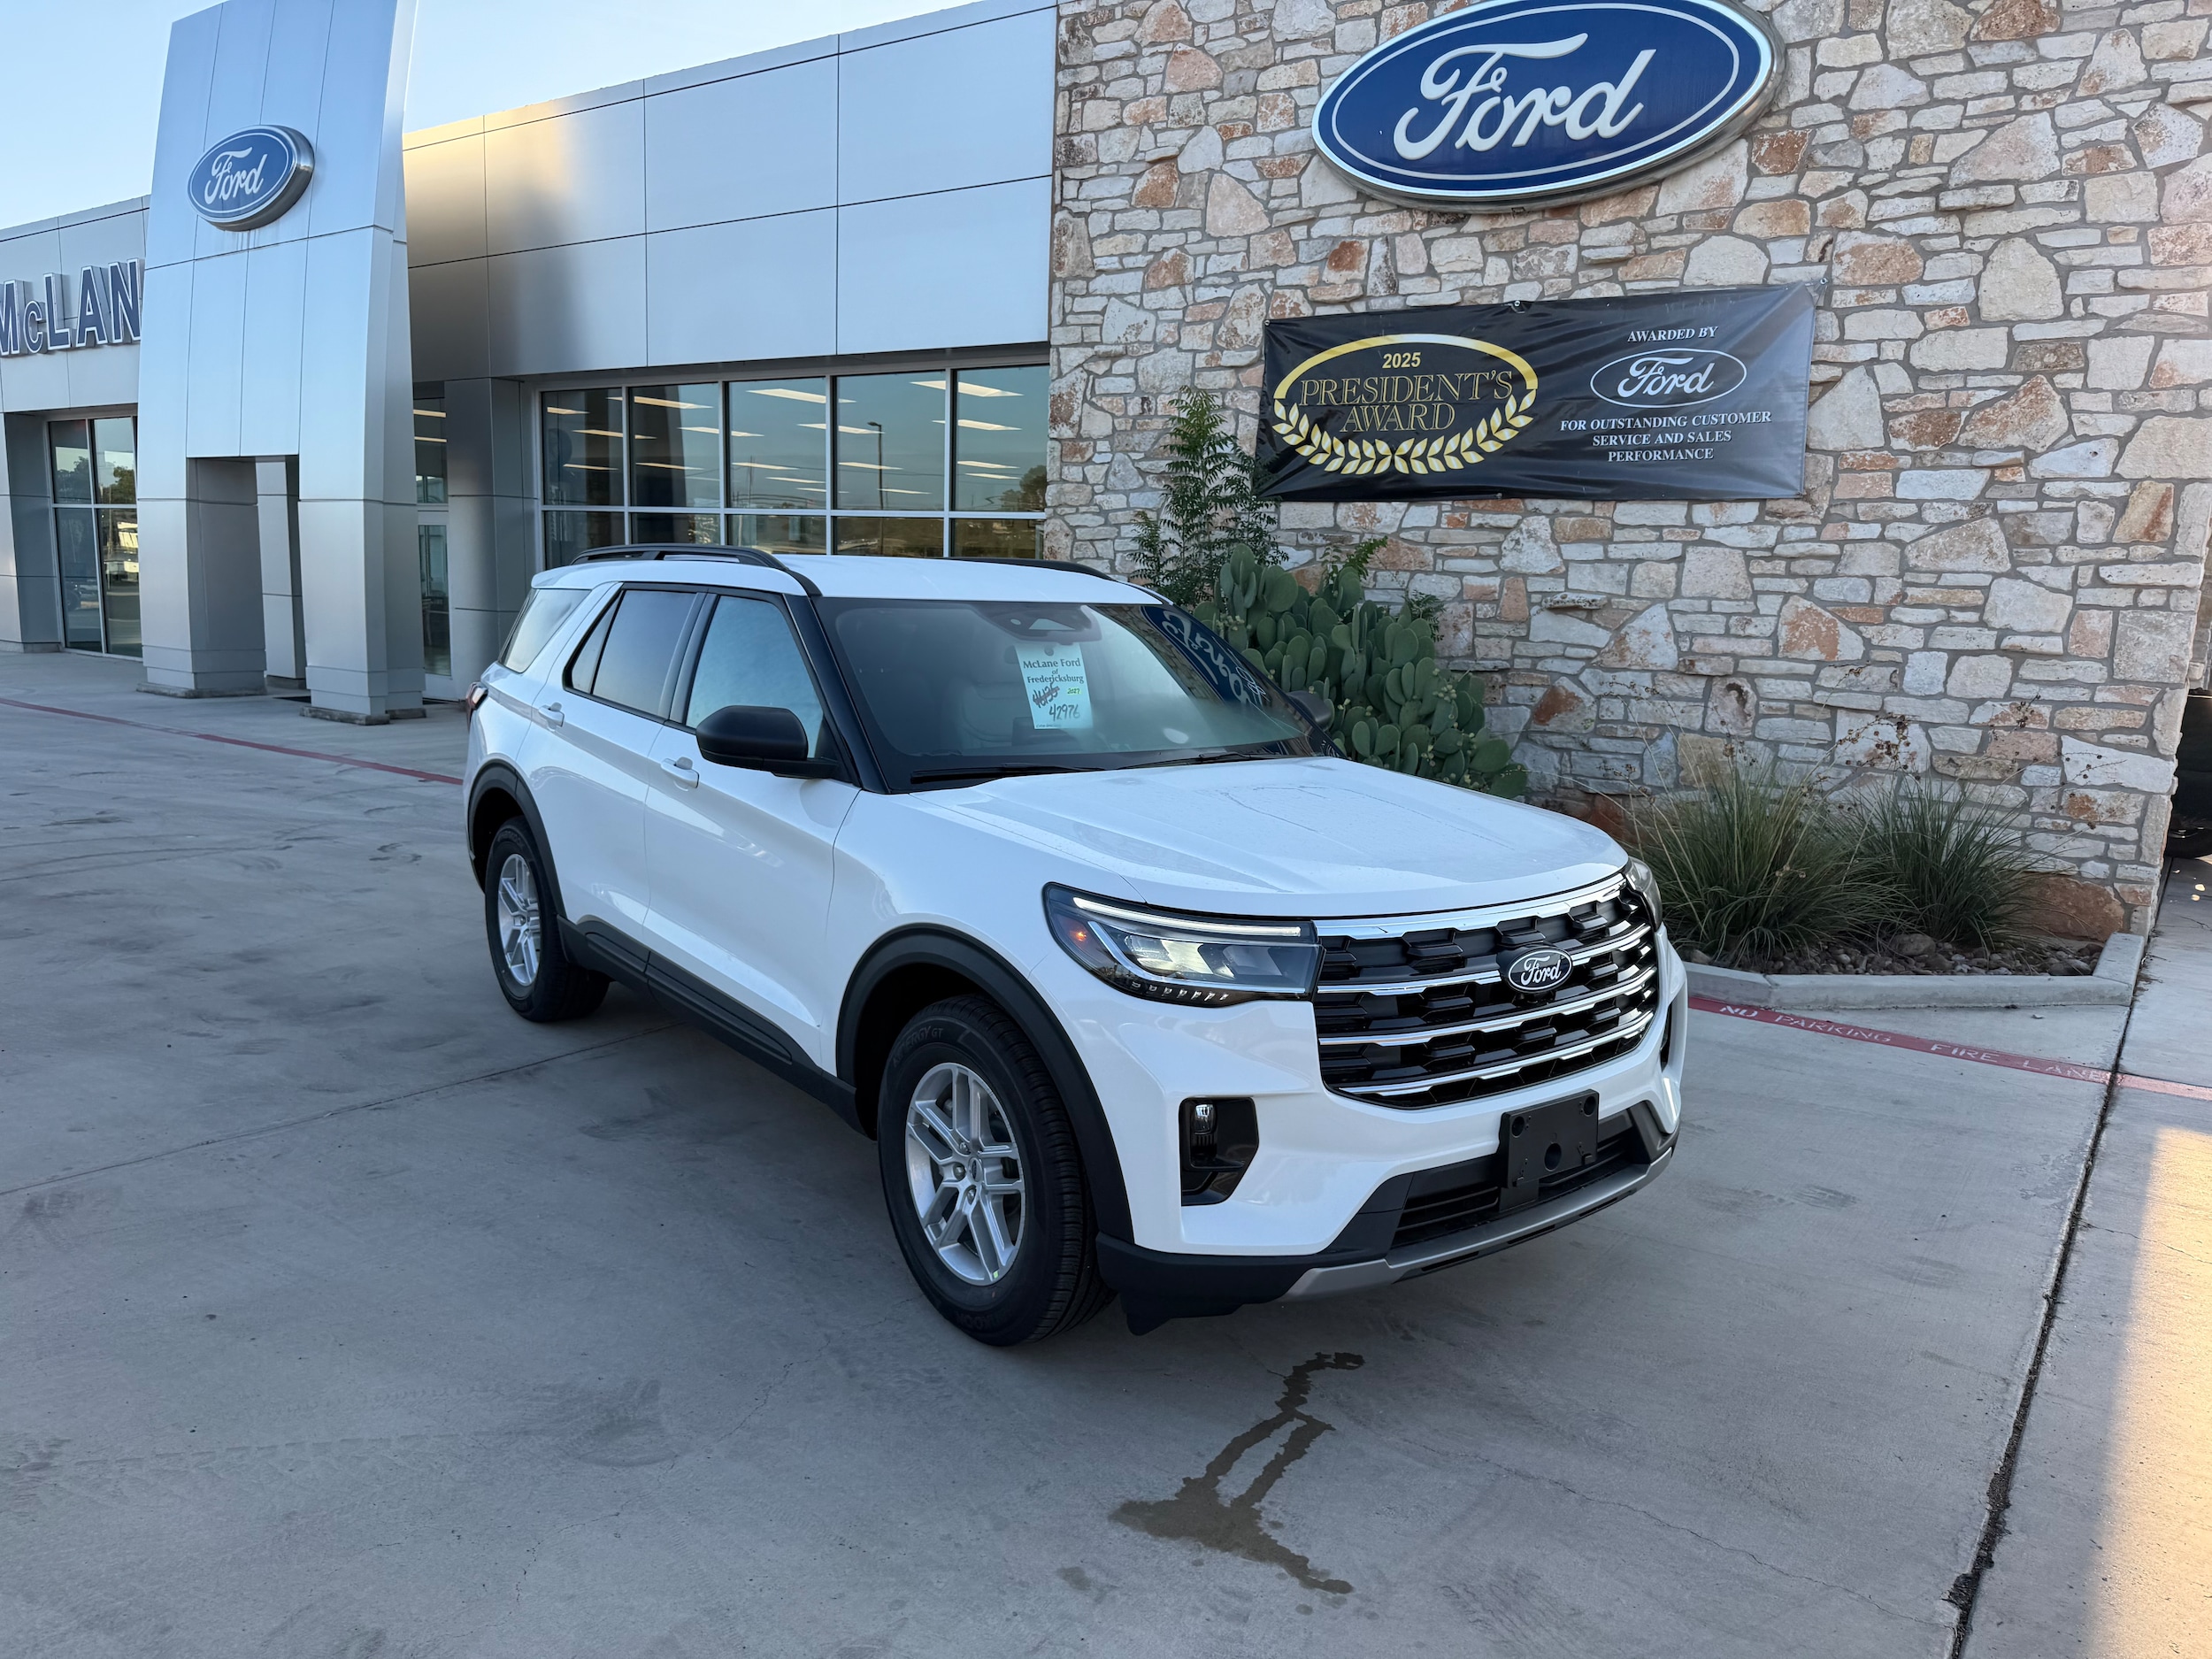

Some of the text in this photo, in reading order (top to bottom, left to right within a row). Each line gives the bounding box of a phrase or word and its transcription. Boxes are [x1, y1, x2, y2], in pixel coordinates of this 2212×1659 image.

[1394, 33, 1656, 160] Ford
[204, 147, 268, 204] Ford
[1627, 326, 1718, 342] AWARDED BY
[1382, 352, 1422, 369] 2025
[1299, 370, 1513, 406] PRESIDENT'S
[1617, 357, 1716, 397] Ford
[1339, 403, 1455, 433] AWARD
[1560, 411, 1771, 431] FOR OUTSTANDING CUSTOMER
[1593, 430, 1732, 447] SERVICE AND SALES
[1608, 449, 1713, 463] PERFORMANCE
[1023, 657, 1081, 669] McLane Ford
[1026, 674, 1084, 684] Fredericksburg
[1521, 956, 1562, 986] Ford
[1719, 1005, 2102, 1081] NO PARKING FIRE LANE
